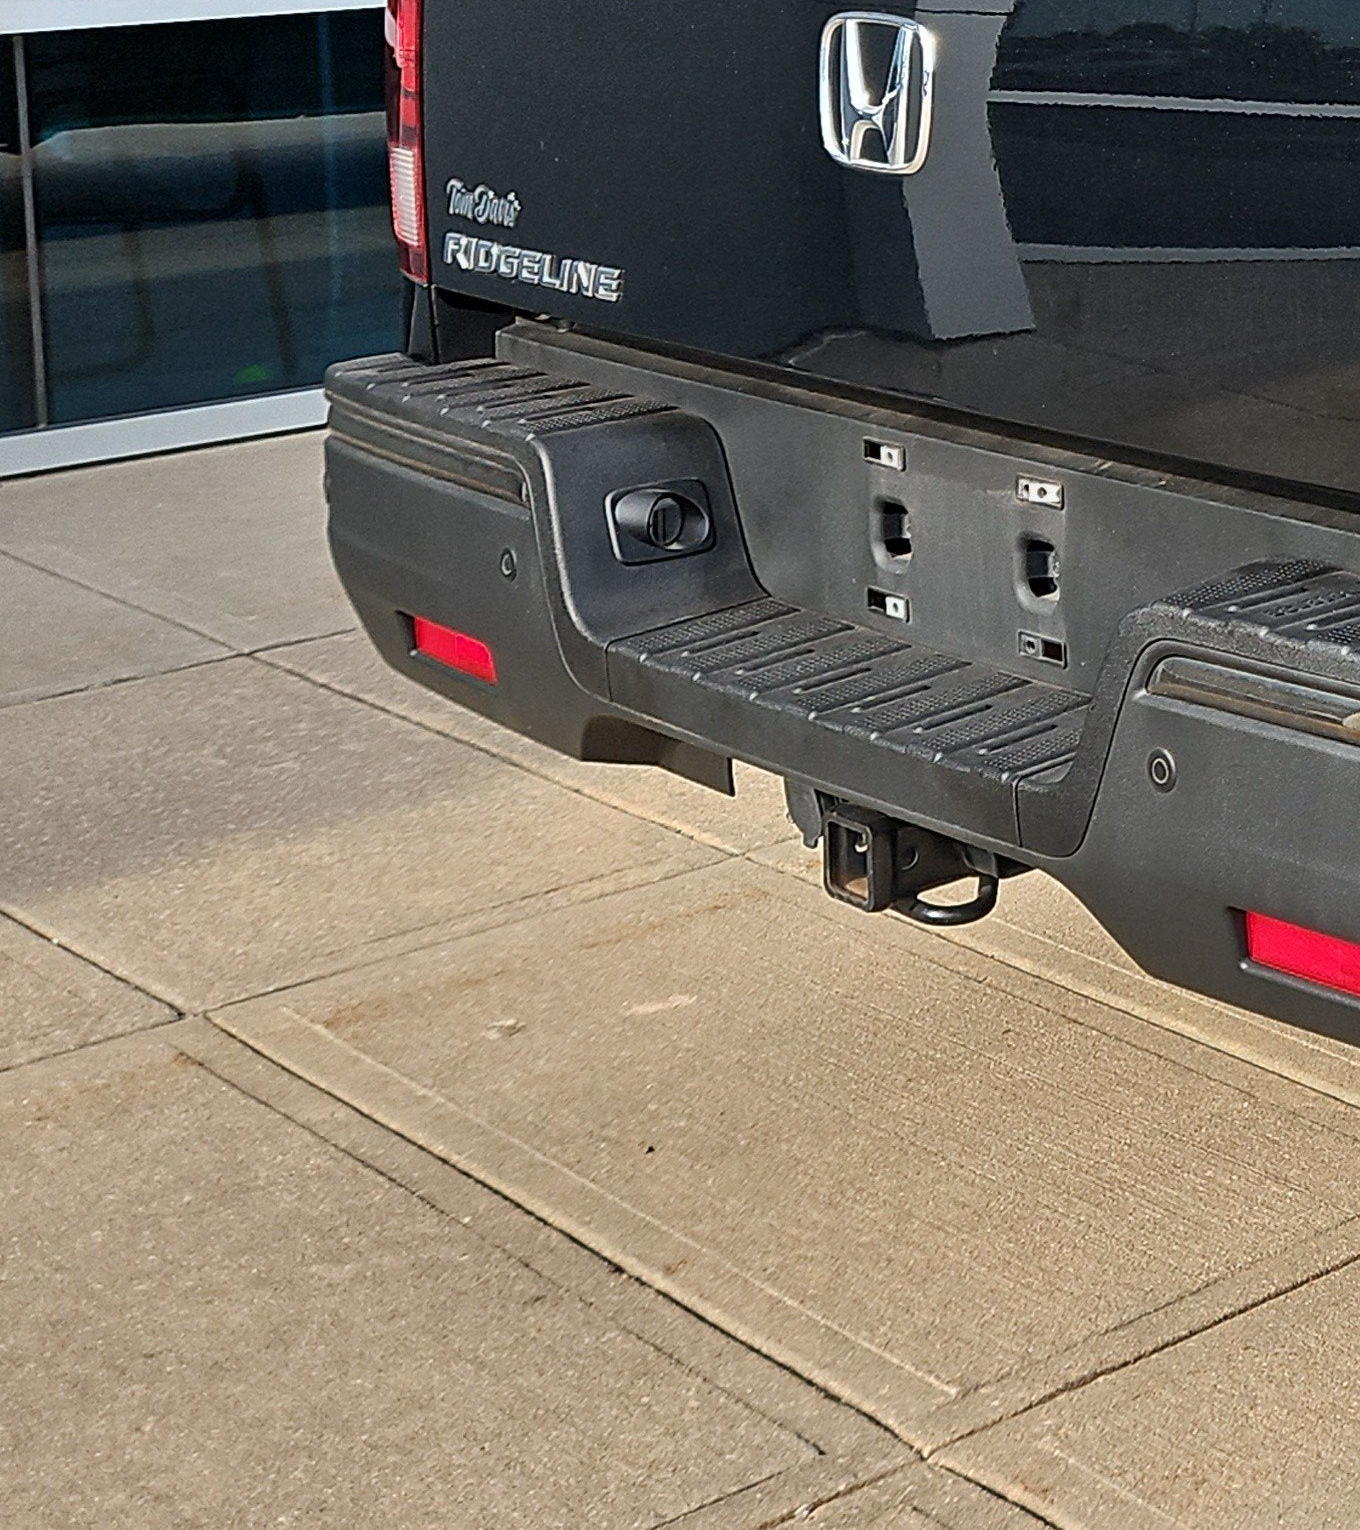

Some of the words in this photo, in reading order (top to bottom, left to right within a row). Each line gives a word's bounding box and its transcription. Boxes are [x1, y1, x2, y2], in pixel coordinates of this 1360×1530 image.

[446, 178, 474, 220] Tom
[474, 183, 522, 228] Davis
[443, 232, 625, 303] RIDGELINE
